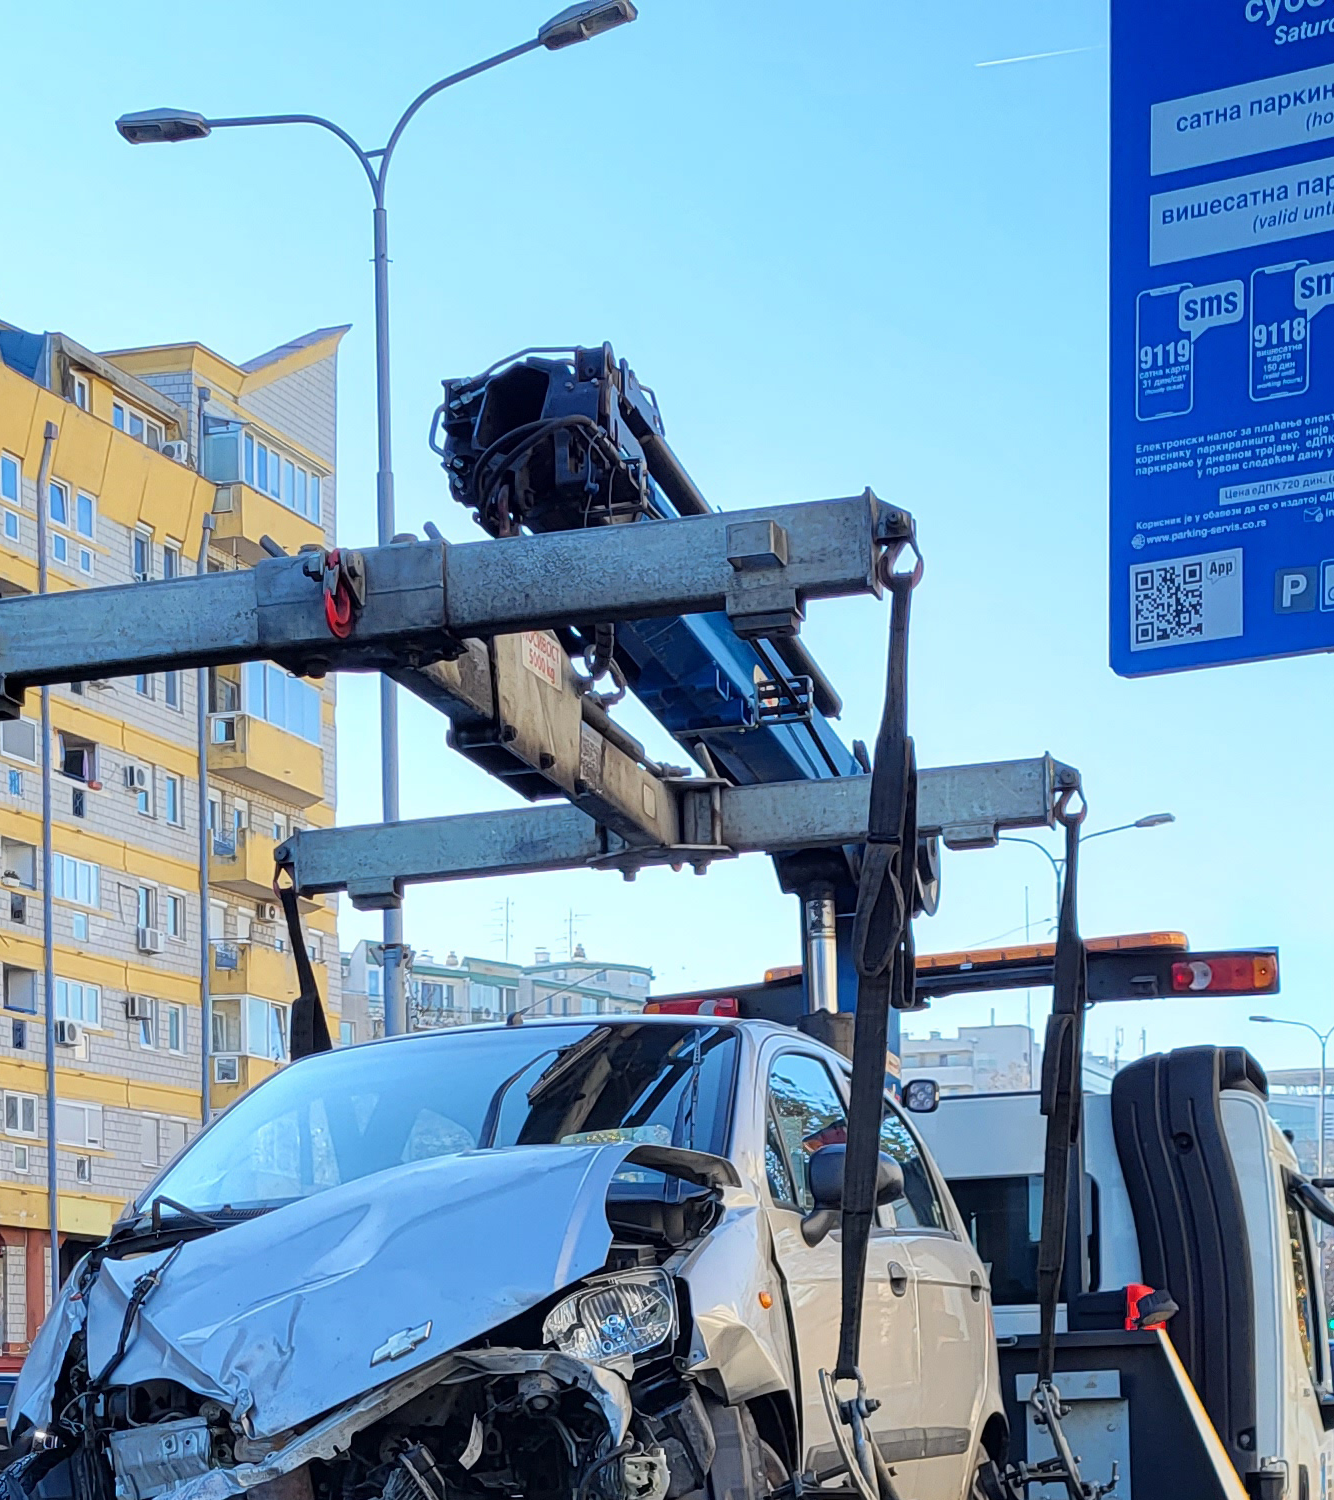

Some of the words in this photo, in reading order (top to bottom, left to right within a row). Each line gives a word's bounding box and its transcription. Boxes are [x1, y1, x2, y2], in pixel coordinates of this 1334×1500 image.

[1175, 103, 1242, 132] сатна
[1161, 184, 1289, 225] вишесатна
[1252, 208, 1298, 233] (valid
[1183, 291, 1239, 322] sms
[1253, 317, 1306, 348] 9118
[1140, 339, 1190, 370] 9119
[1165, 364, 1190, 376] карта
[1263, 363, 1277, 372] 150
[1207, 430, 1238, 442] налог
[1240, 428, 1252, 436] за
[1280, 431, 1300, 441] ако
[1196, 458, 1203, 467] у
[1197, 469, 1203, 478] у
[1206, 464, 1240, 476] првом
[1297, 449, 1323, 461] дану
[1326, 448, 1333, 458] у
[1224, 488, 1250, 500] Цена
[1282, 480, 1299, 490] 720
[1302, 476, 1327, 488] дин.
[1195, 514, 1201, 522] у
[1244, 506, 1256, 515] да
[1146, 520, 1267, 544] www.parking-servis.co.rs
[1209, 560, 1233, 577] App
[1282, 574, 1308, 608] P
